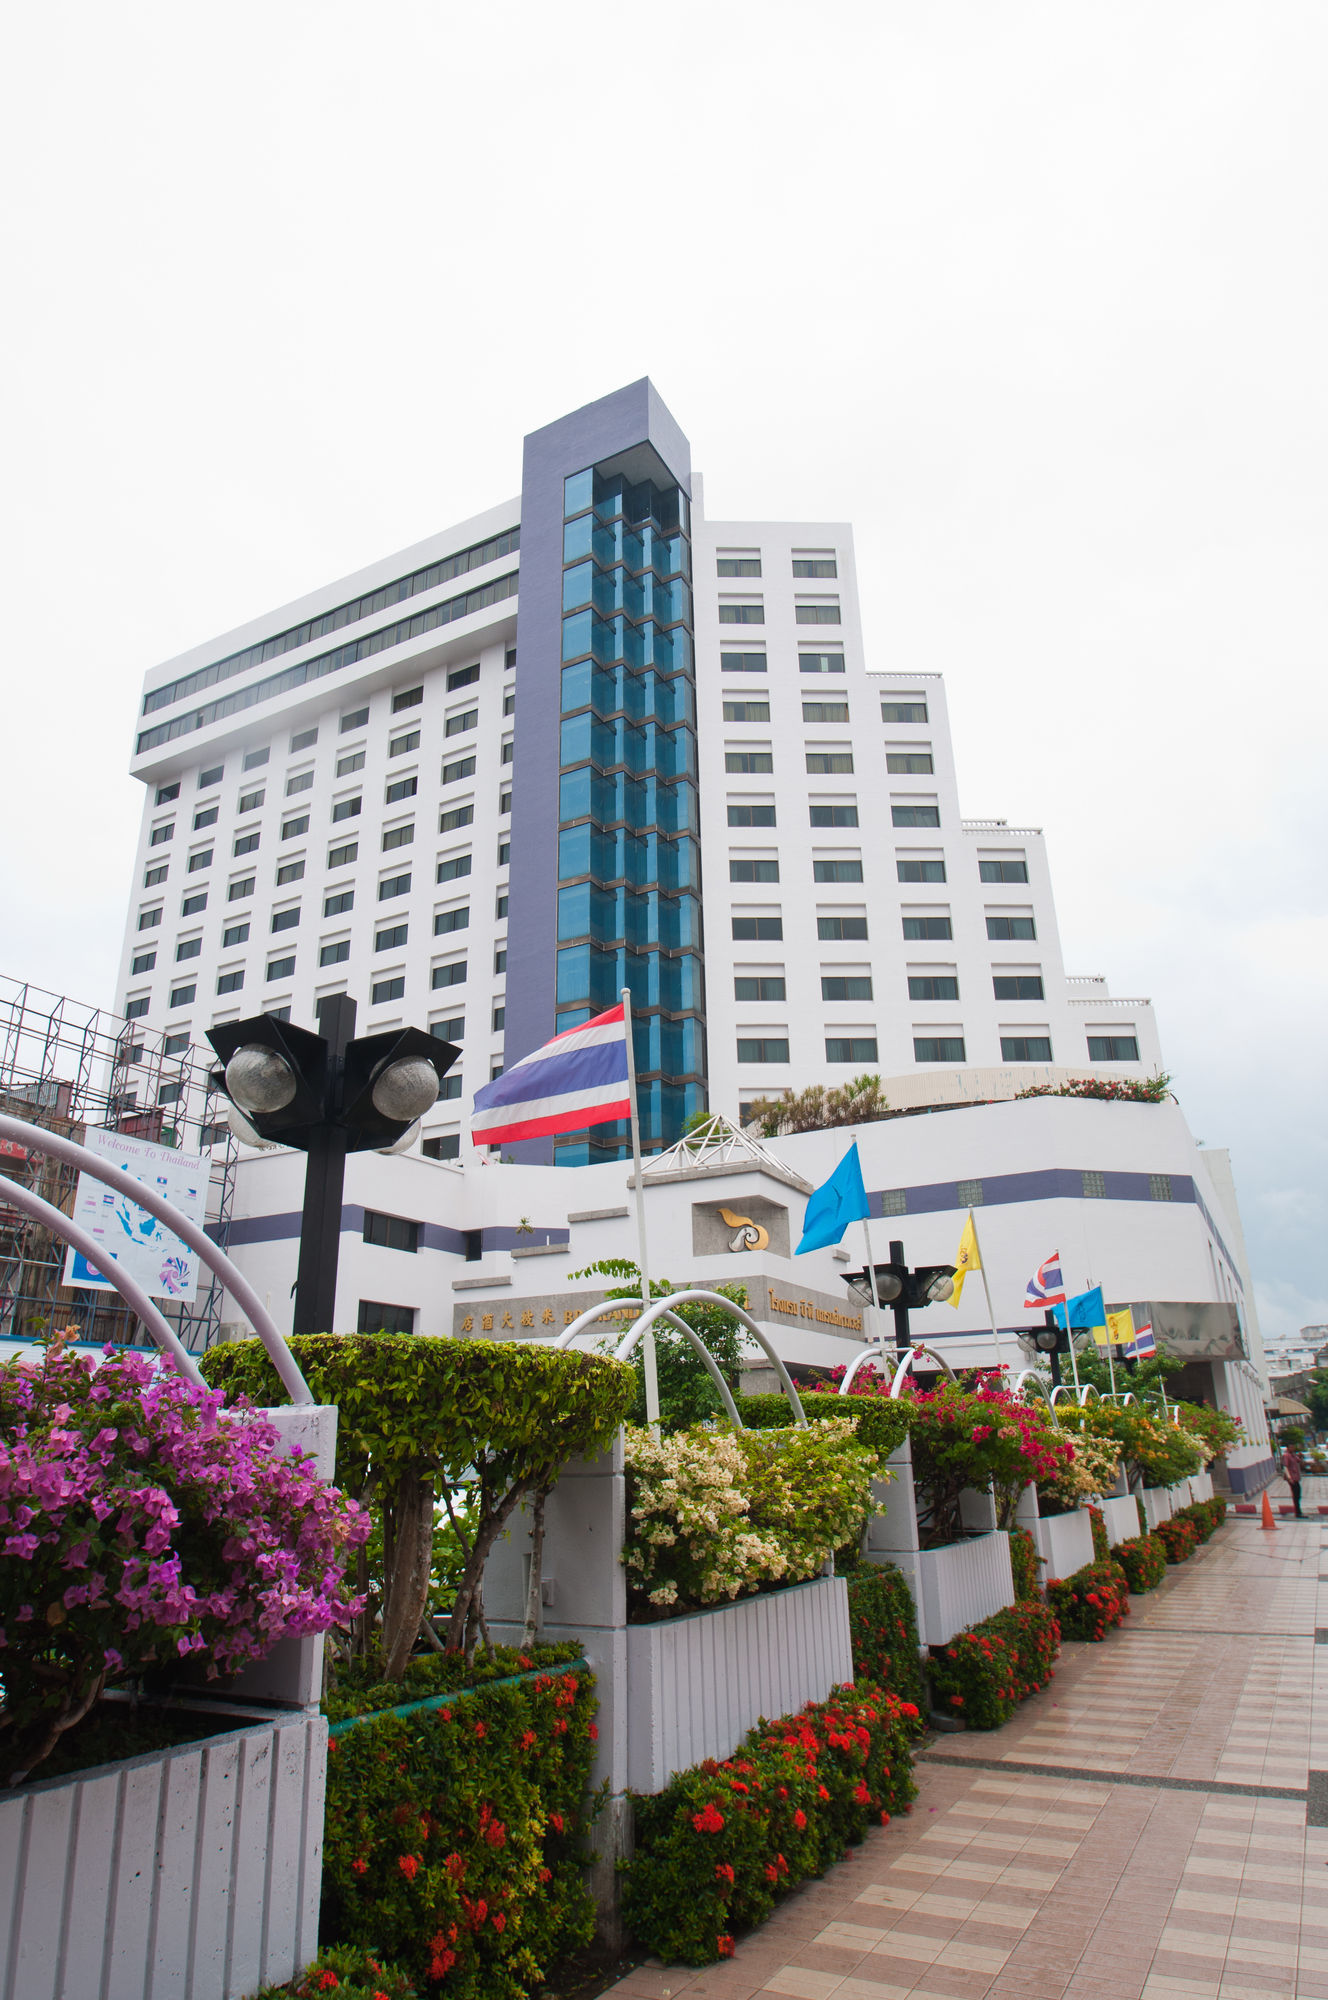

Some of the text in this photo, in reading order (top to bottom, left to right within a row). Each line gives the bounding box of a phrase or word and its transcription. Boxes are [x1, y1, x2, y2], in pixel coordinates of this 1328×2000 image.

[98, 1134, 201, 1170] Welcome To Thailand
[768, 1288, 799, 1317] โรงแรม
